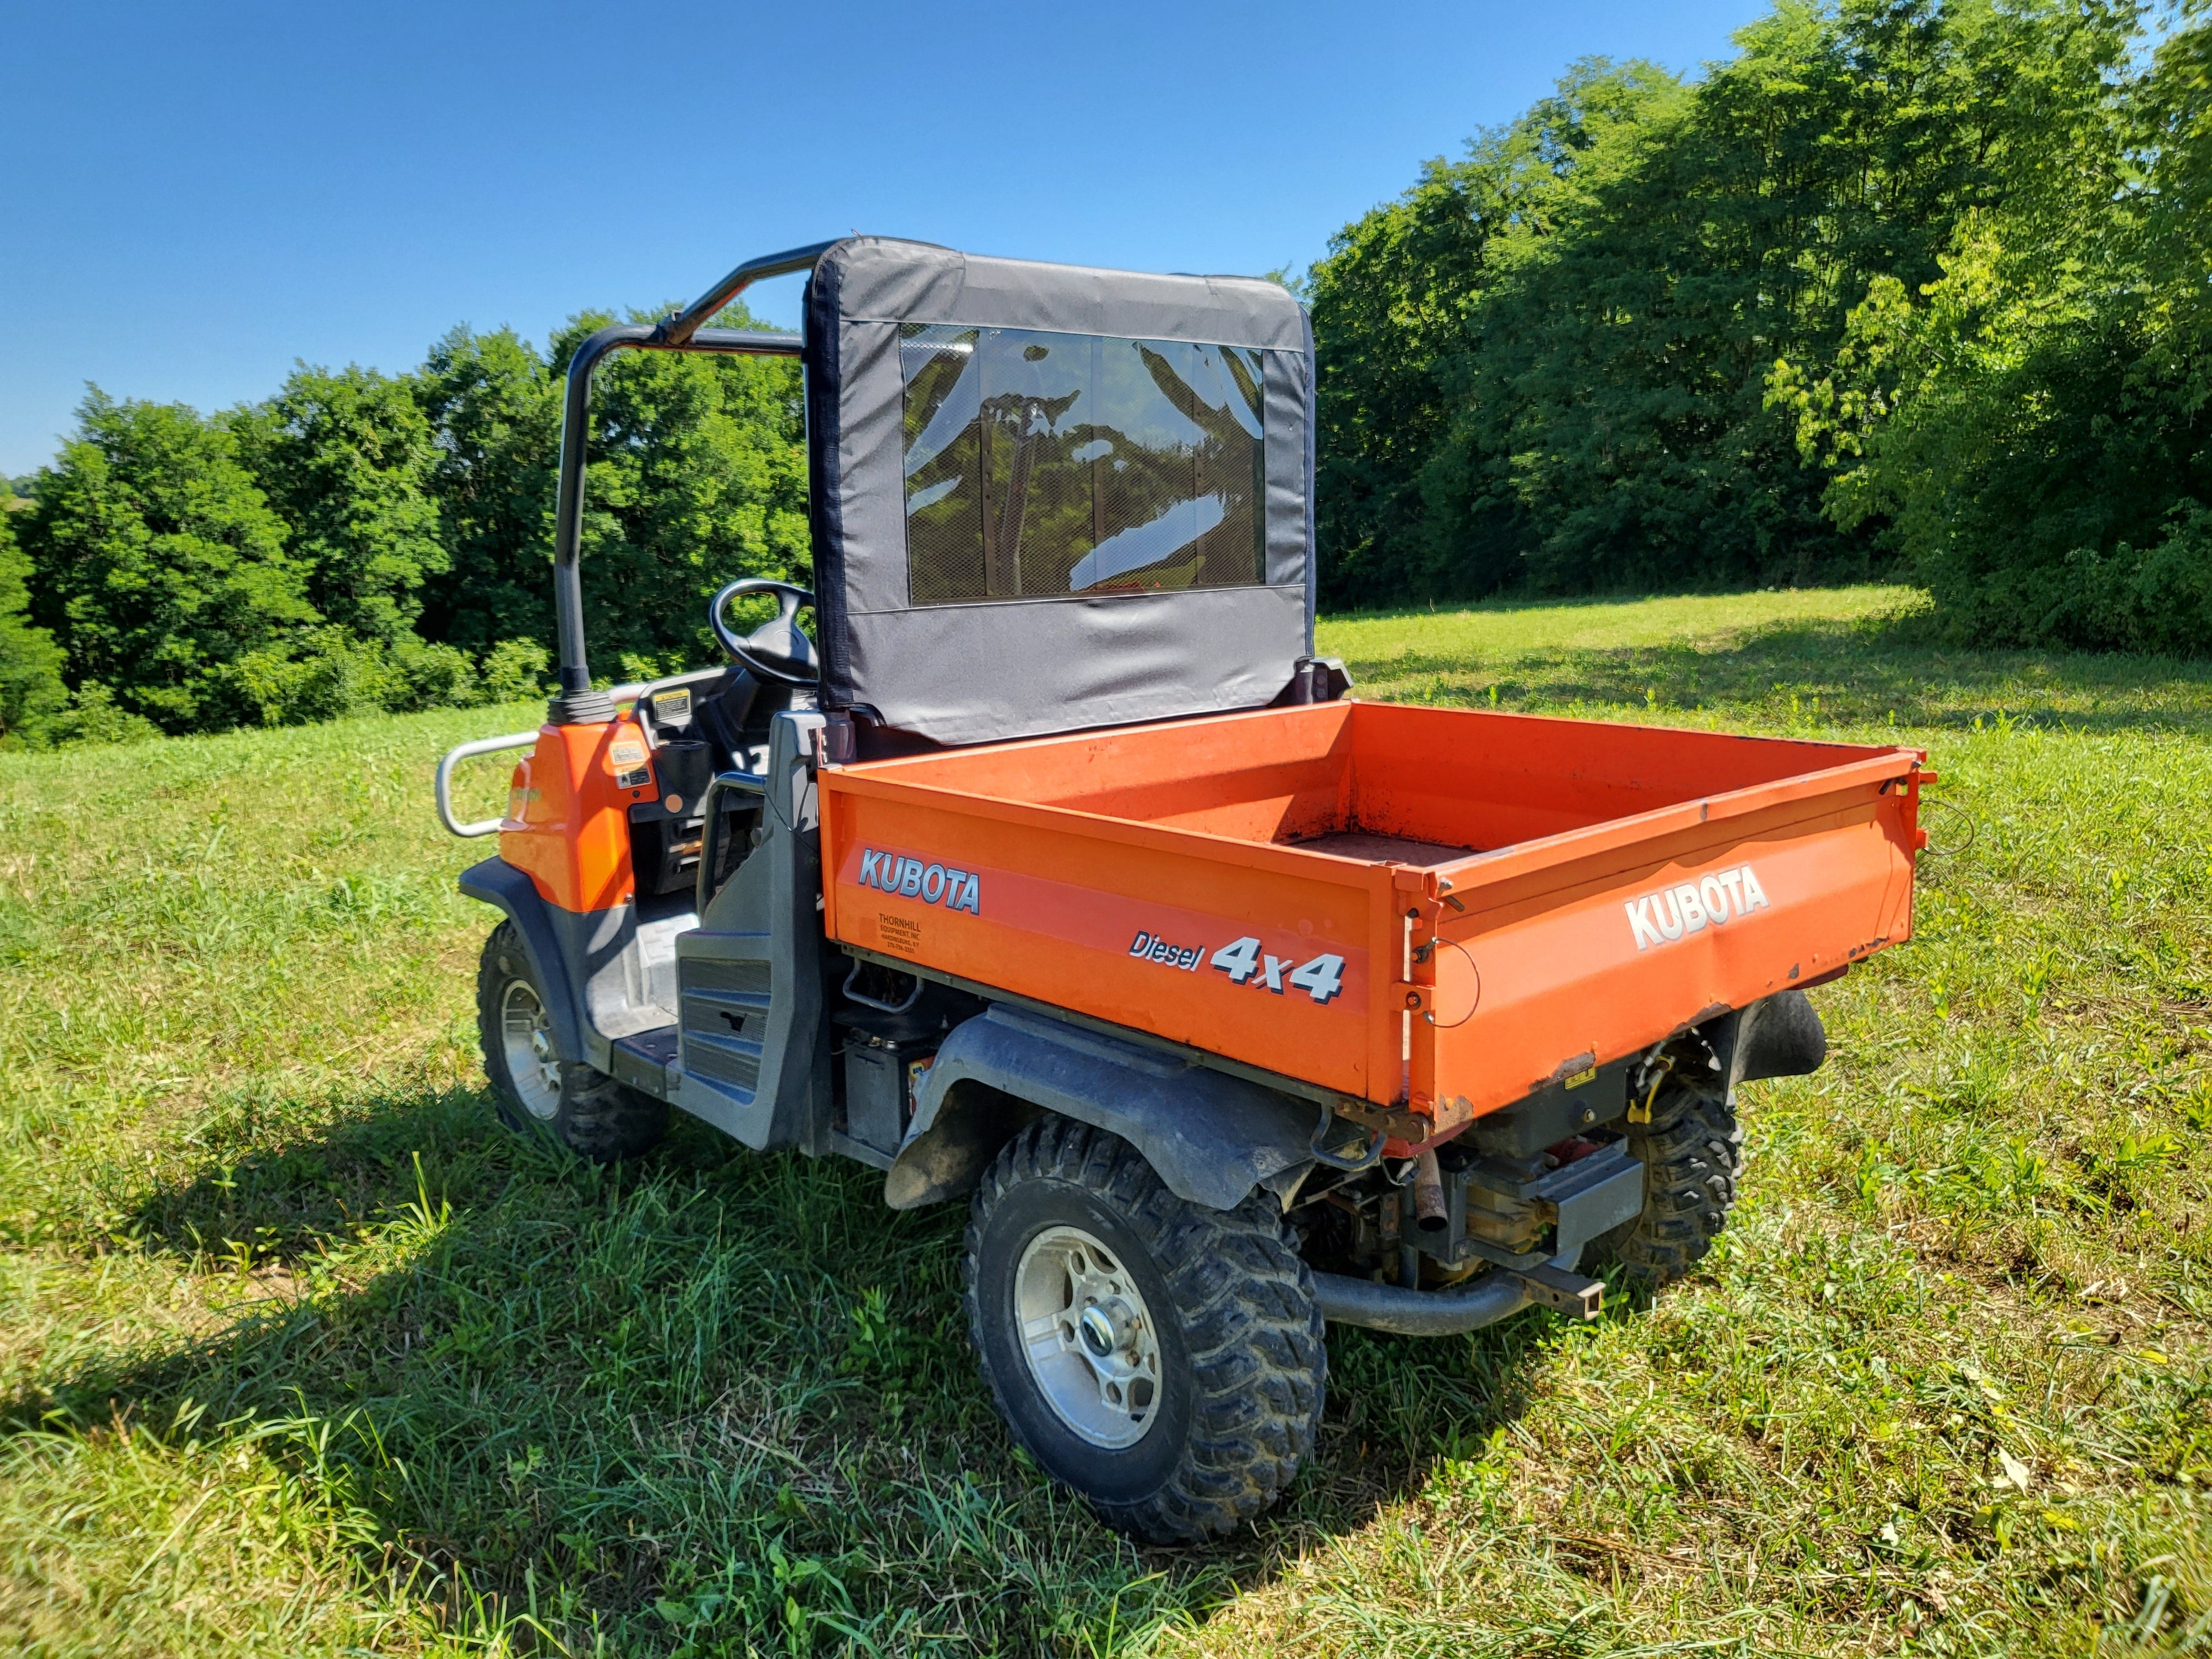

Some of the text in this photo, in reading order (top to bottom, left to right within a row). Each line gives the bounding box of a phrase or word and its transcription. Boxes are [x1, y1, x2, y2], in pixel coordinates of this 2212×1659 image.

[858, 848, 980, 915] KUBOTA
[1624, 864, 1771, 951] KUBOTA
[879, 914, 921, 932] THORNHILL
[880, 925, 910, 938] EQUIPMENT,
[1129, 930, 1347, 1005] Diesel 4x4
